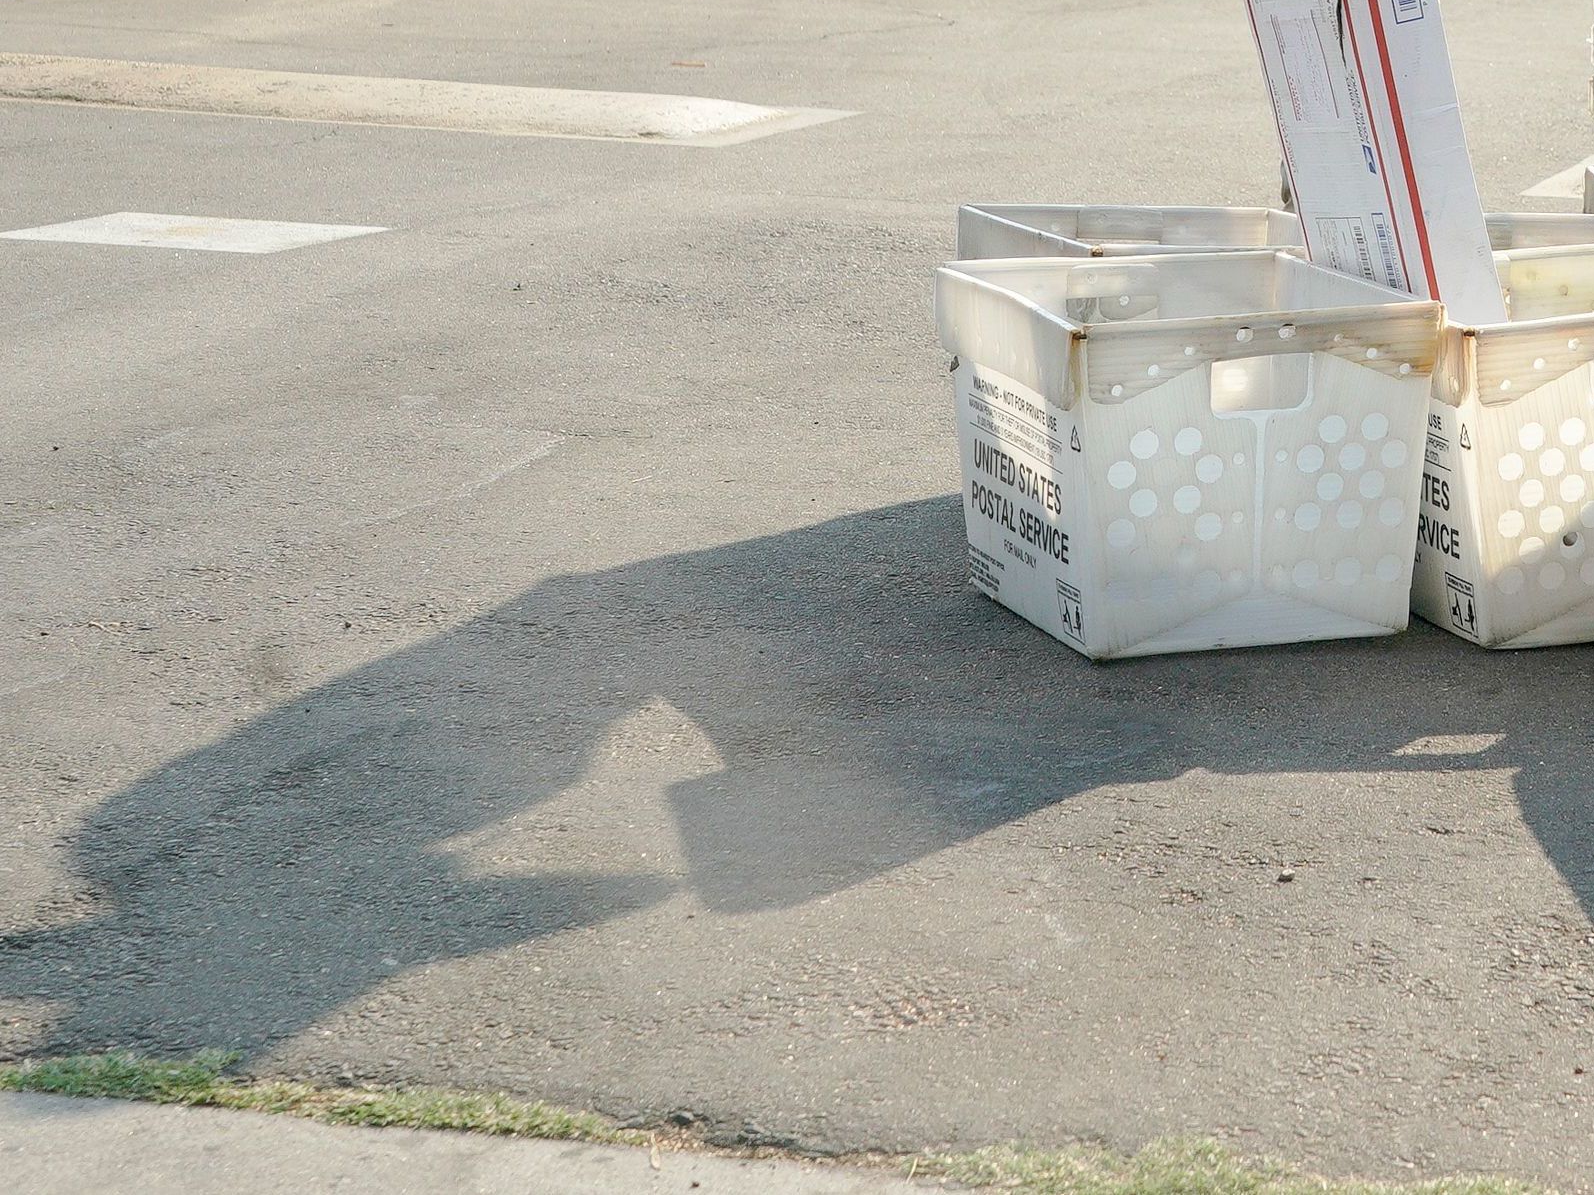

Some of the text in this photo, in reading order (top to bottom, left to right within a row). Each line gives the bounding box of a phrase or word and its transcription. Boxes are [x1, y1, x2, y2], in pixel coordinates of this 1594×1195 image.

[1358, 110, 1370, 144] POSTAL
[972, 375, 1057, 432] WARNING NOT FOR PRIVATE USE
[1428, 412, 1442, 431] USE
[974, 438, 1062, 516] UNITED STATES
[1420, 474, 1450, 512] TES
[971, 479, 1069, 565] POSTAL SERVICE
[1418, 515, 1460, 560] RVICE
[1004, 538, 1037, 569] FOR MAIL ONLY
